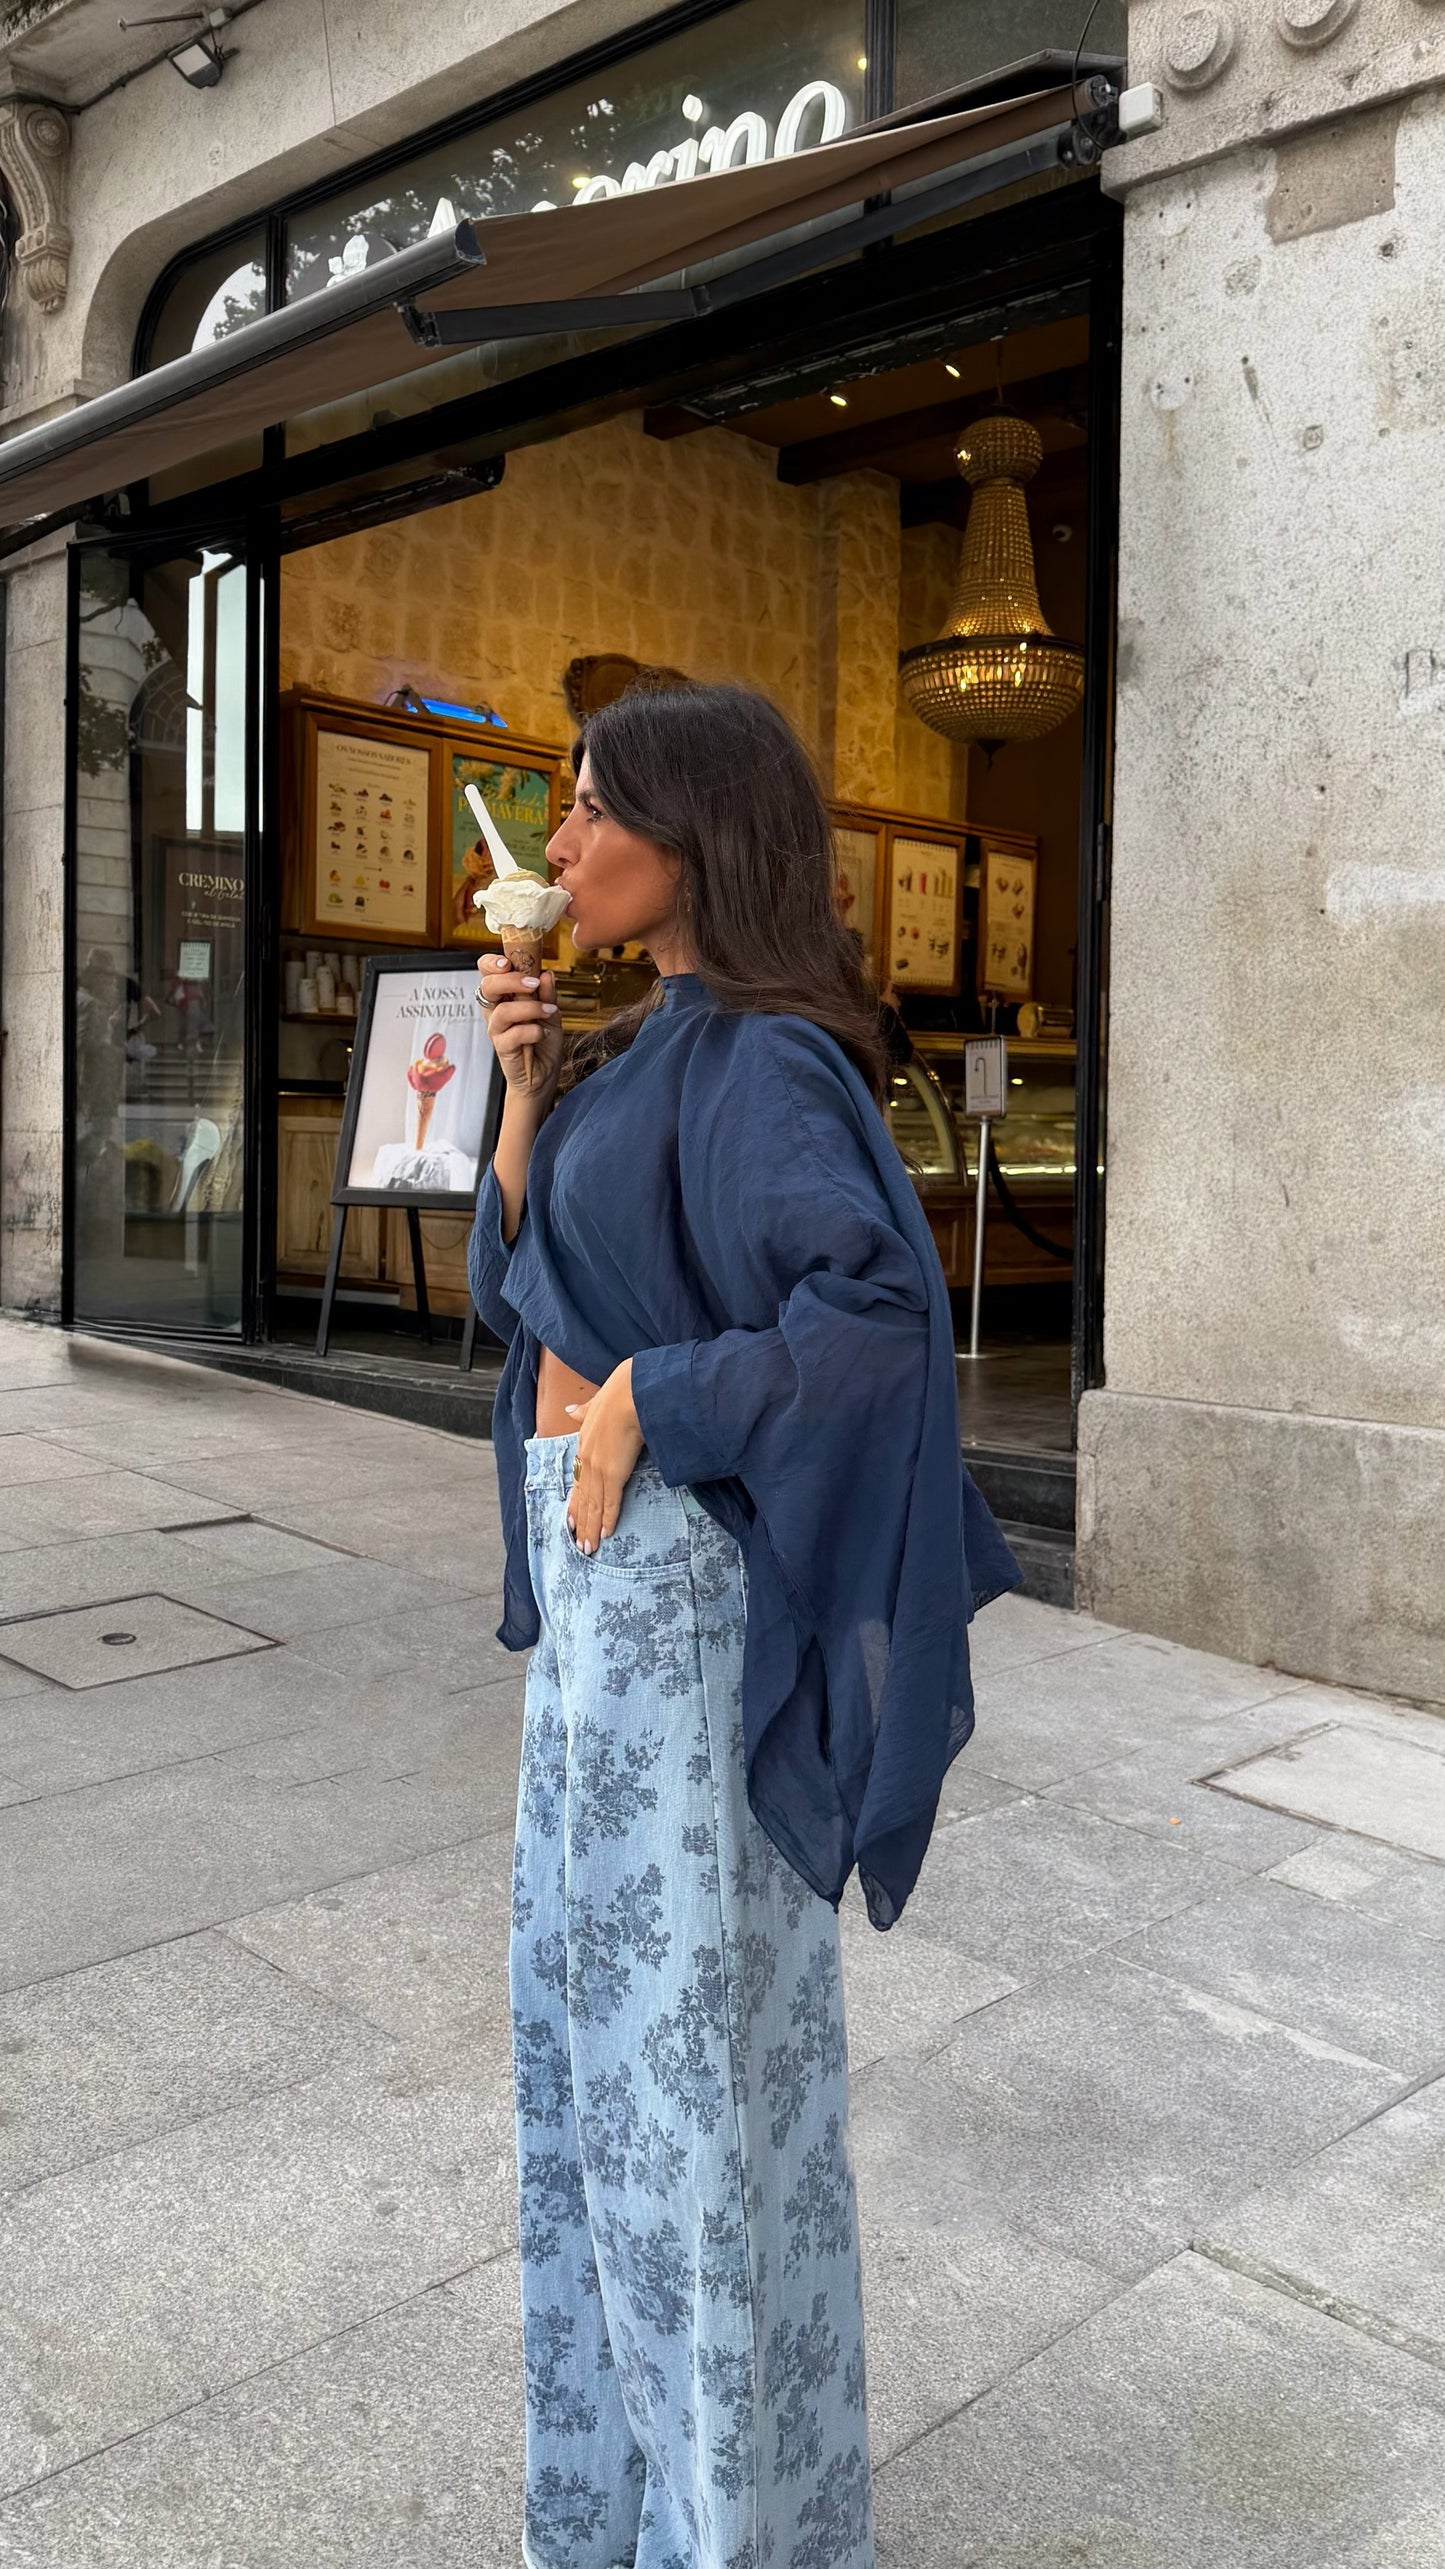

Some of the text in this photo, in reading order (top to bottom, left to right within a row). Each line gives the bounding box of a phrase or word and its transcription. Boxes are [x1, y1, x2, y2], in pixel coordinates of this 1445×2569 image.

[427, 80, 847, 239] rino
[458, 795, 544, 826] PMAVERA
[178, 872, 245, 891] CREMINO
[217, 888, 245, 901] Gelat
[409, 986, 465, 1001] A NOSSA
[396, 1004, 475, 1019] ASSINATURA
